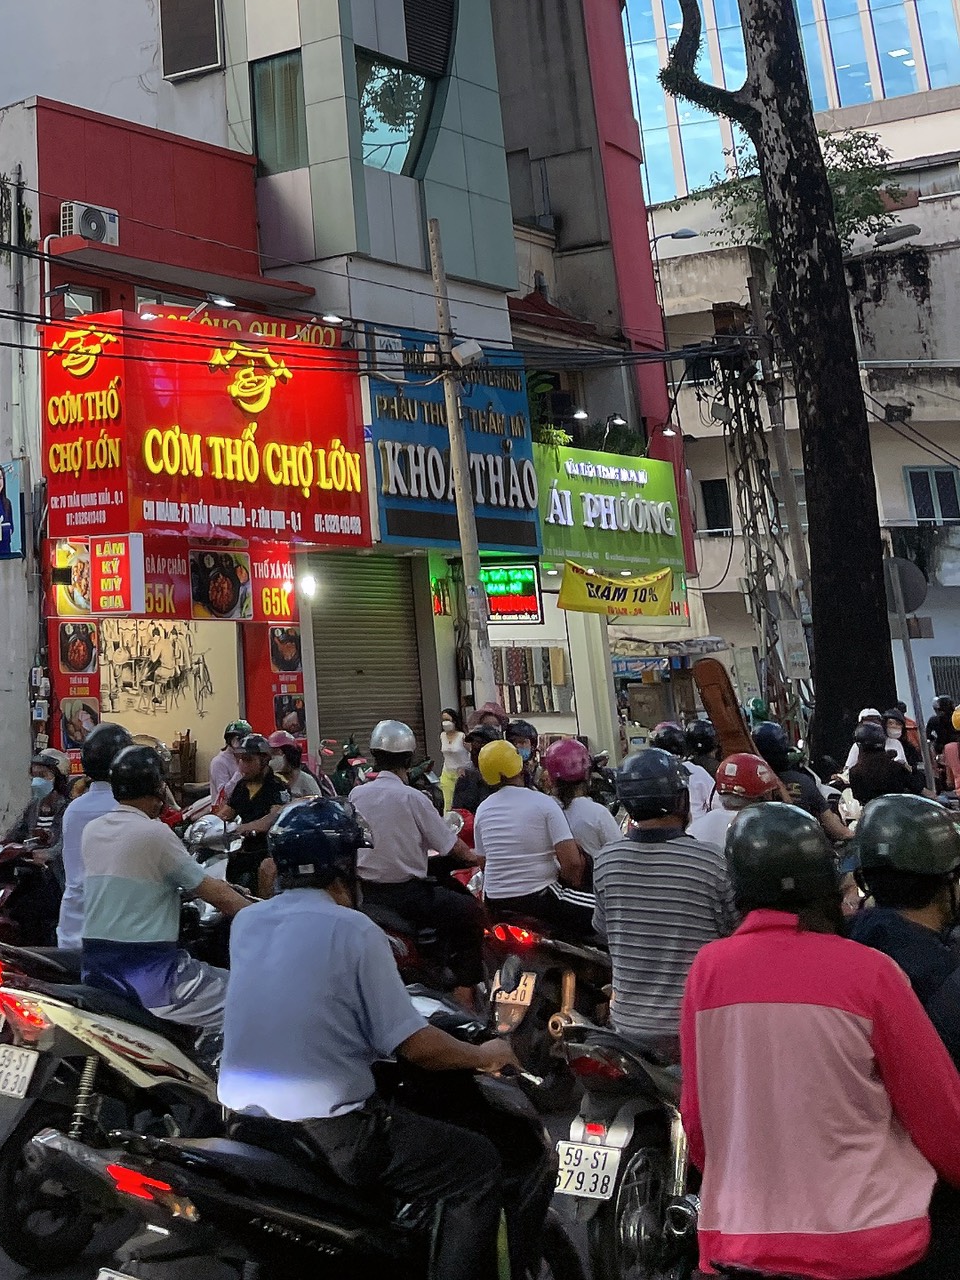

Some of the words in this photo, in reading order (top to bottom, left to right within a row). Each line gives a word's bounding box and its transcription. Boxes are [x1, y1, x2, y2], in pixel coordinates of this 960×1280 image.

[48, 391, 83, 425] CƠM
[421, 401, 464, 429] THU
[49, 437, 83, 478] CHỢ
[86, 429, 120, 470] LỚN
[144, 425, 203, 478] CƠM
[206, 421, 260, 483] THỐ
[264, 440, 314, 499] CHỢ
[316, 438, 362, 493] LỚN
[469, 438, 539, 510] THẢO
[545, 479, 574, 527] ÁI
[580, 491, 678, 537] PHƯƠNG
[96, 541, 125, 557] LÂM
[145, 554, 156, 574] GÀ
[156, 554, 166, 574] ÁP
[167, 554, 187, 576] CHẢO
[270, 560, 281, 579] XÁ
[100, 595, 124, 609] GIA
[145, 583, 176, 614] 55K
[262, 587, 290, 616] 65K
[586, 581, 628, 602] GIẢM
[632, 587, 658, 604] 10%
[564, 1146, 608, 1171] 59-S1
